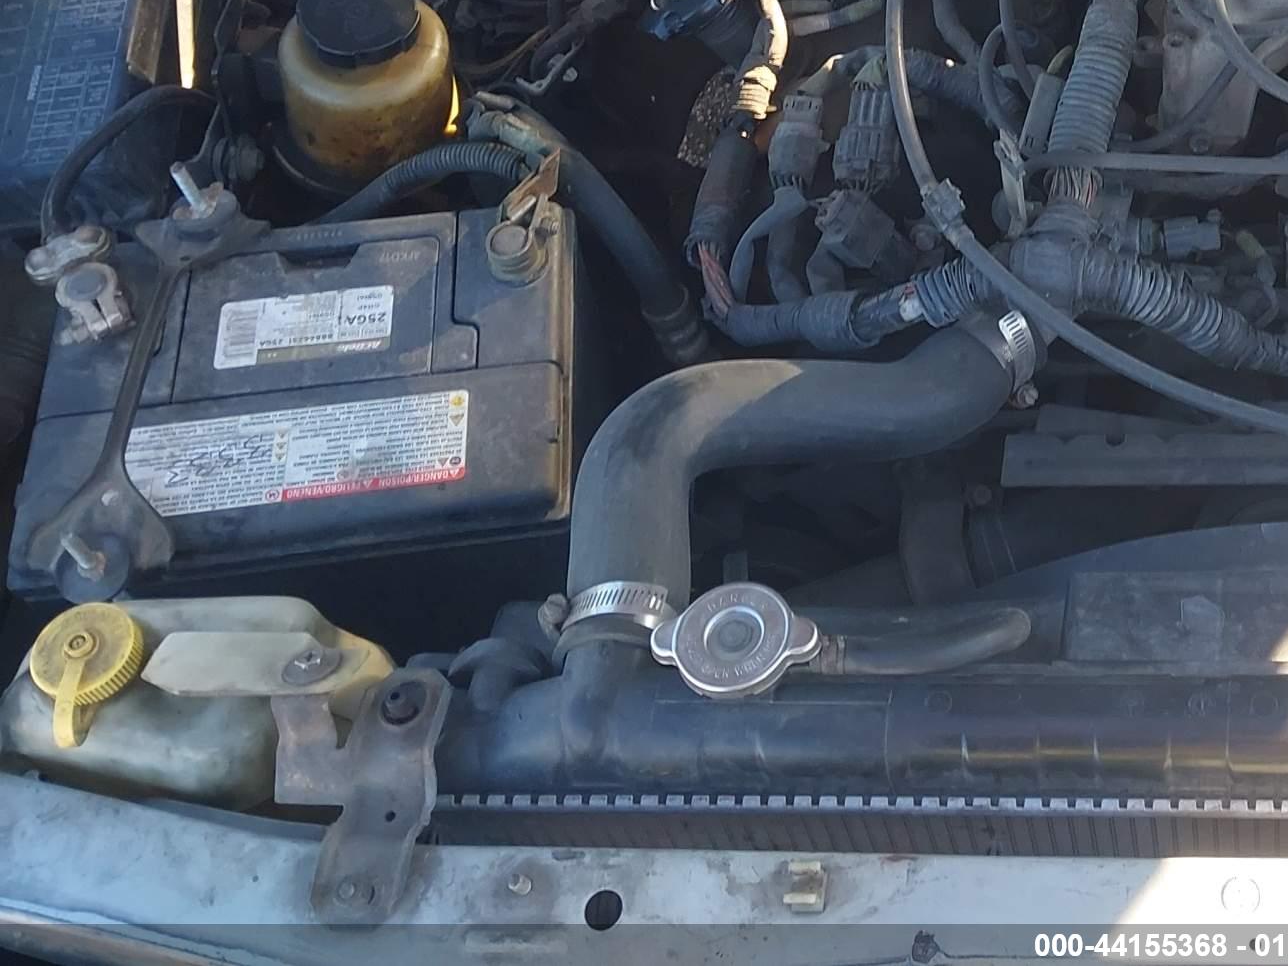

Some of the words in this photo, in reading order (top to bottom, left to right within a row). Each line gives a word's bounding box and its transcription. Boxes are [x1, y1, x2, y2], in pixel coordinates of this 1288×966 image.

[345, 311, 387, 326] 25GA
[378, 470, 449, 488] DANGER/POISON
[286, 482, 361, 498] PELIGRO/VENENO
